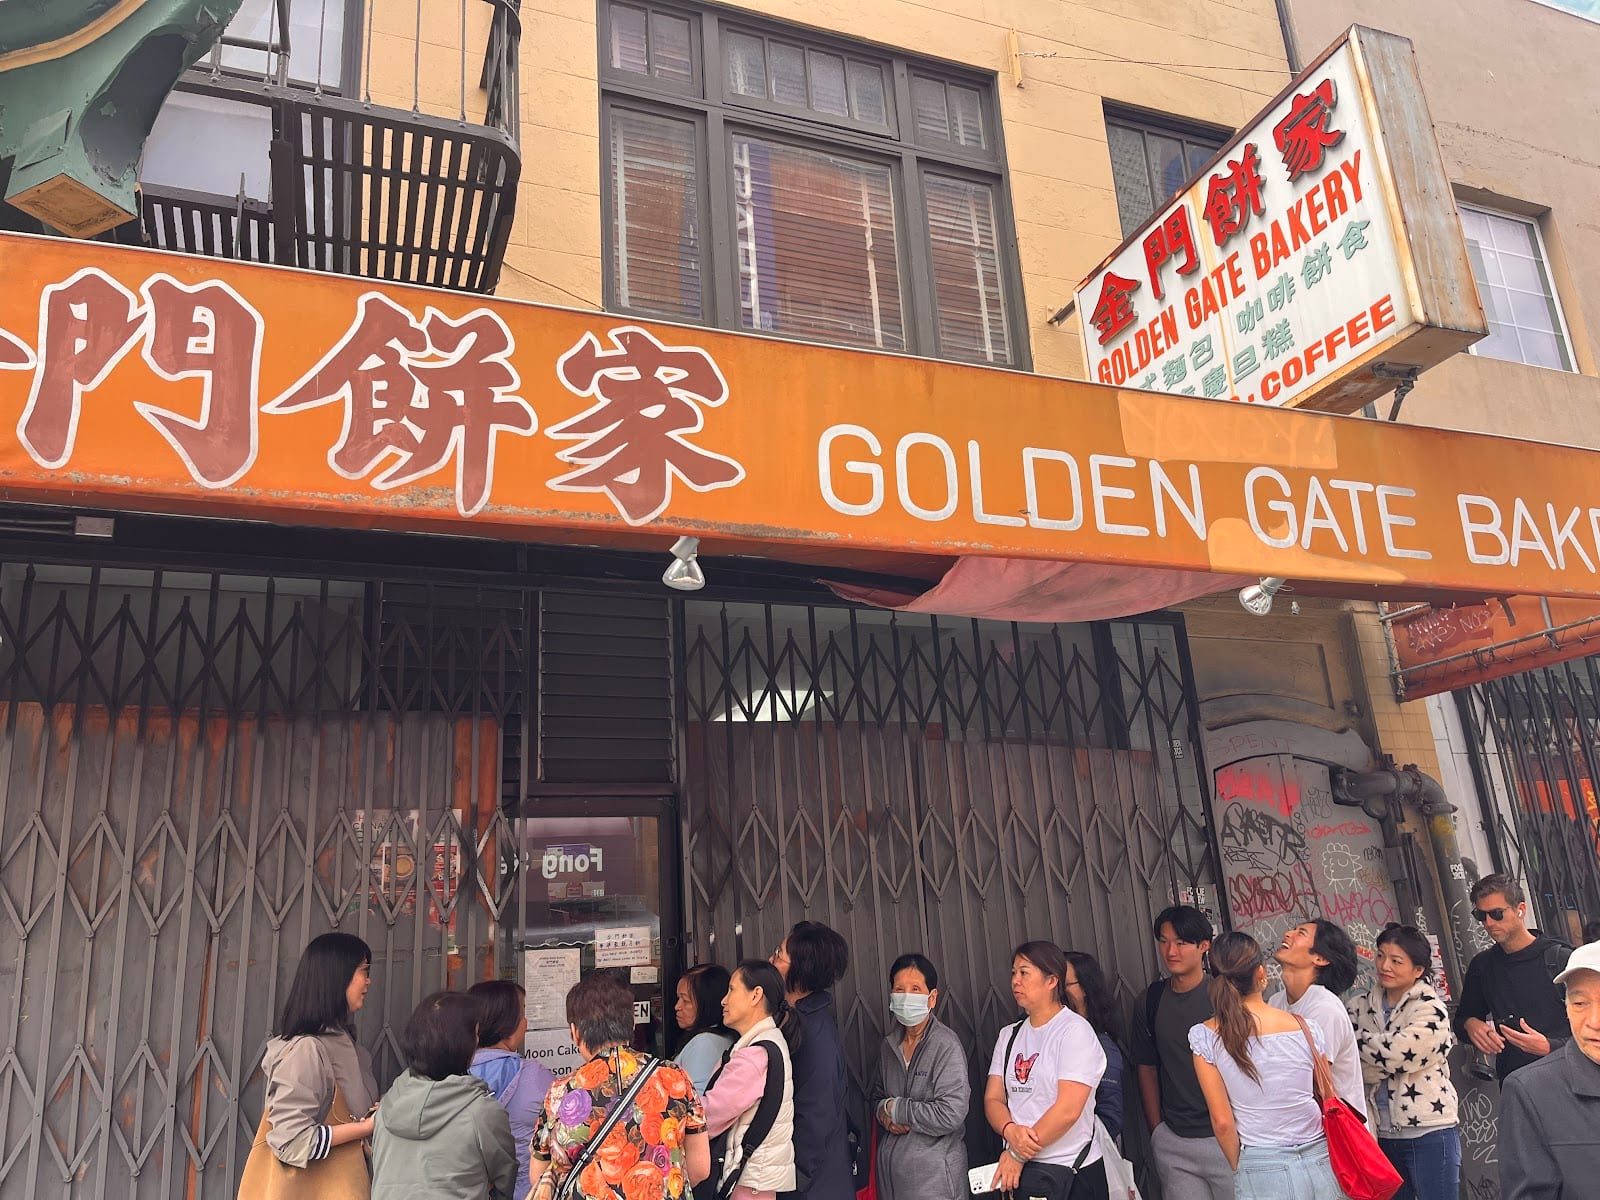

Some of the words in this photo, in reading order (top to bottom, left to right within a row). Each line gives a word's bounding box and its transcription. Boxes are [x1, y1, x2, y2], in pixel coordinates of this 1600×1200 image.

[1089, 78, 1347, 345] 金門餅家
[1098, 305, 1180, 386] GOLDEN
[1184, 251, 1246, 330] GATE
[1250, 149, 1363, 280] BAKERY
[0, 267, 747, 526] 門餅家
[817, 423, 1207, 541] GOLDEN
[1243, 466, 1433, 561] GATE
[633, 1003, 649, 1018] EN
